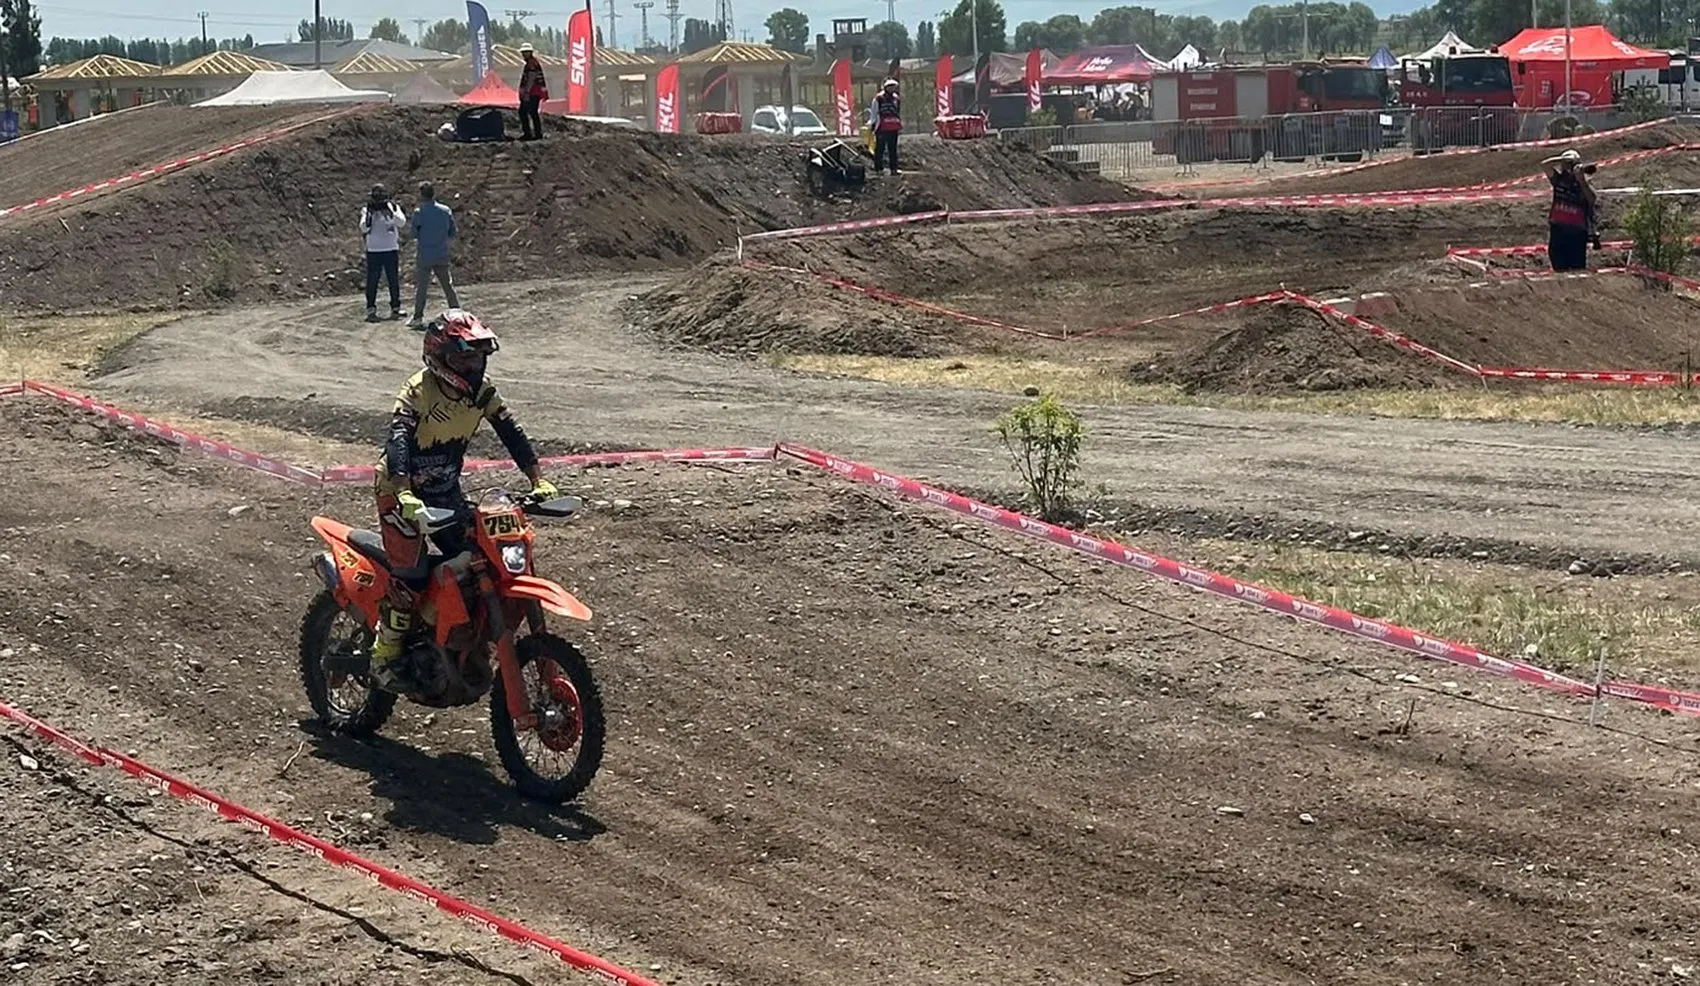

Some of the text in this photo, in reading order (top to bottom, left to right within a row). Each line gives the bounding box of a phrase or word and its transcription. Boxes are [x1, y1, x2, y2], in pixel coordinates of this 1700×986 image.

[571, 37, 587, 86] SKIL
[837, 90, 852, 136] SKIL
[938, 85, 950, 117] KIL
[1030, 80, 1042, 113] KIL
[484, 514, 521, 536] 754
